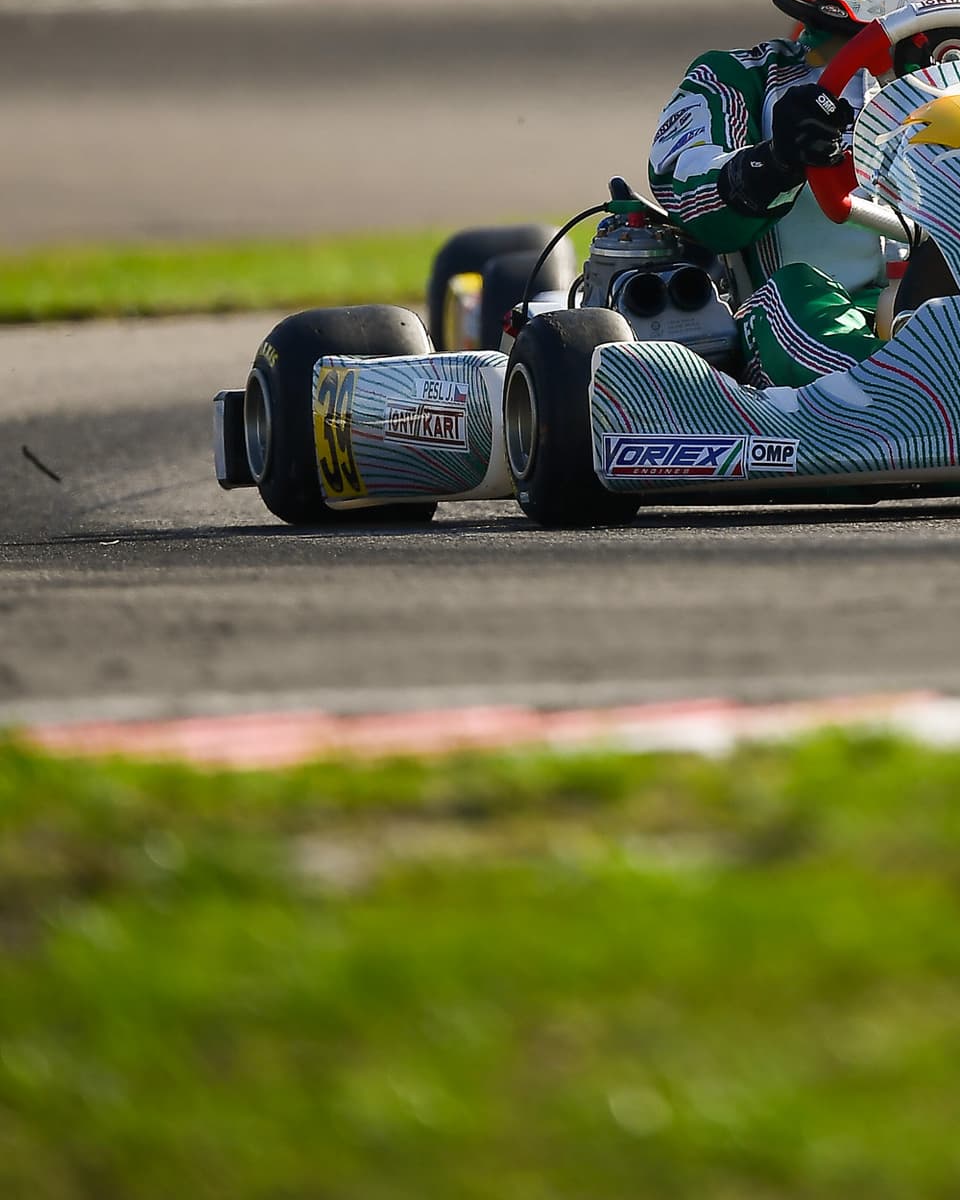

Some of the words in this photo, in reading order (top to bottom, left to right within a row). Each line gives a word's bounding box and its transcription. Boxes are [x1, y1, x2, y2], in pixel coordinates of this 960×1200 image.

[817, 95, 835, 113] OMP
[422, 380, 444, 400] PESL
[317, 369, 361, 493] 39
[604, 438, 737, 472] VORTEX
[751, 444, 794, 463] OMP
